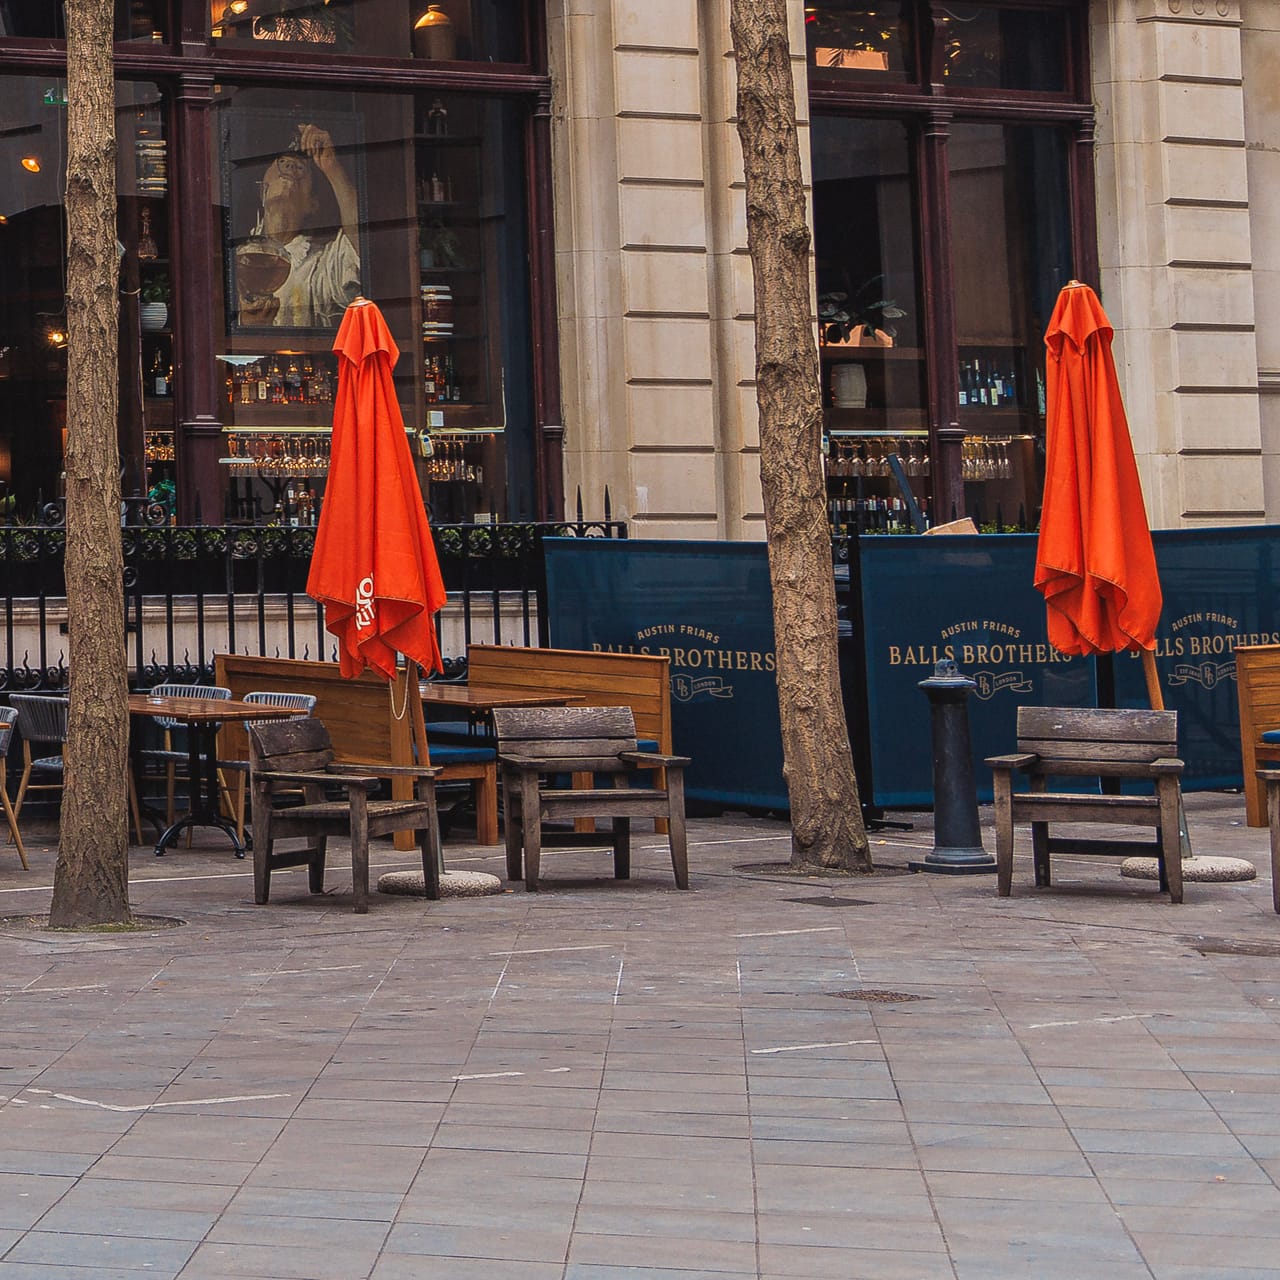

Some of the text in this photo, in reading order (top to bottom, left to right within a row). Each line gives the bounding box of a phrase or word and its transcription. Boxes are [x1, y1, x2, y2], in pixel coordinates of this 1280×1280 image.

[941, 620, 1021, 640] AUSTIN FRIARS
[1172, 612, 1238, 632] AUSTIN FRIARS
[637, 624, 720, 644] AUSTIN FRIARS
[659, 647, 776, 671] BROTHERS
[889, 644, 956, 665] BALLS
[994, 677, 1017, 687] LONDON
